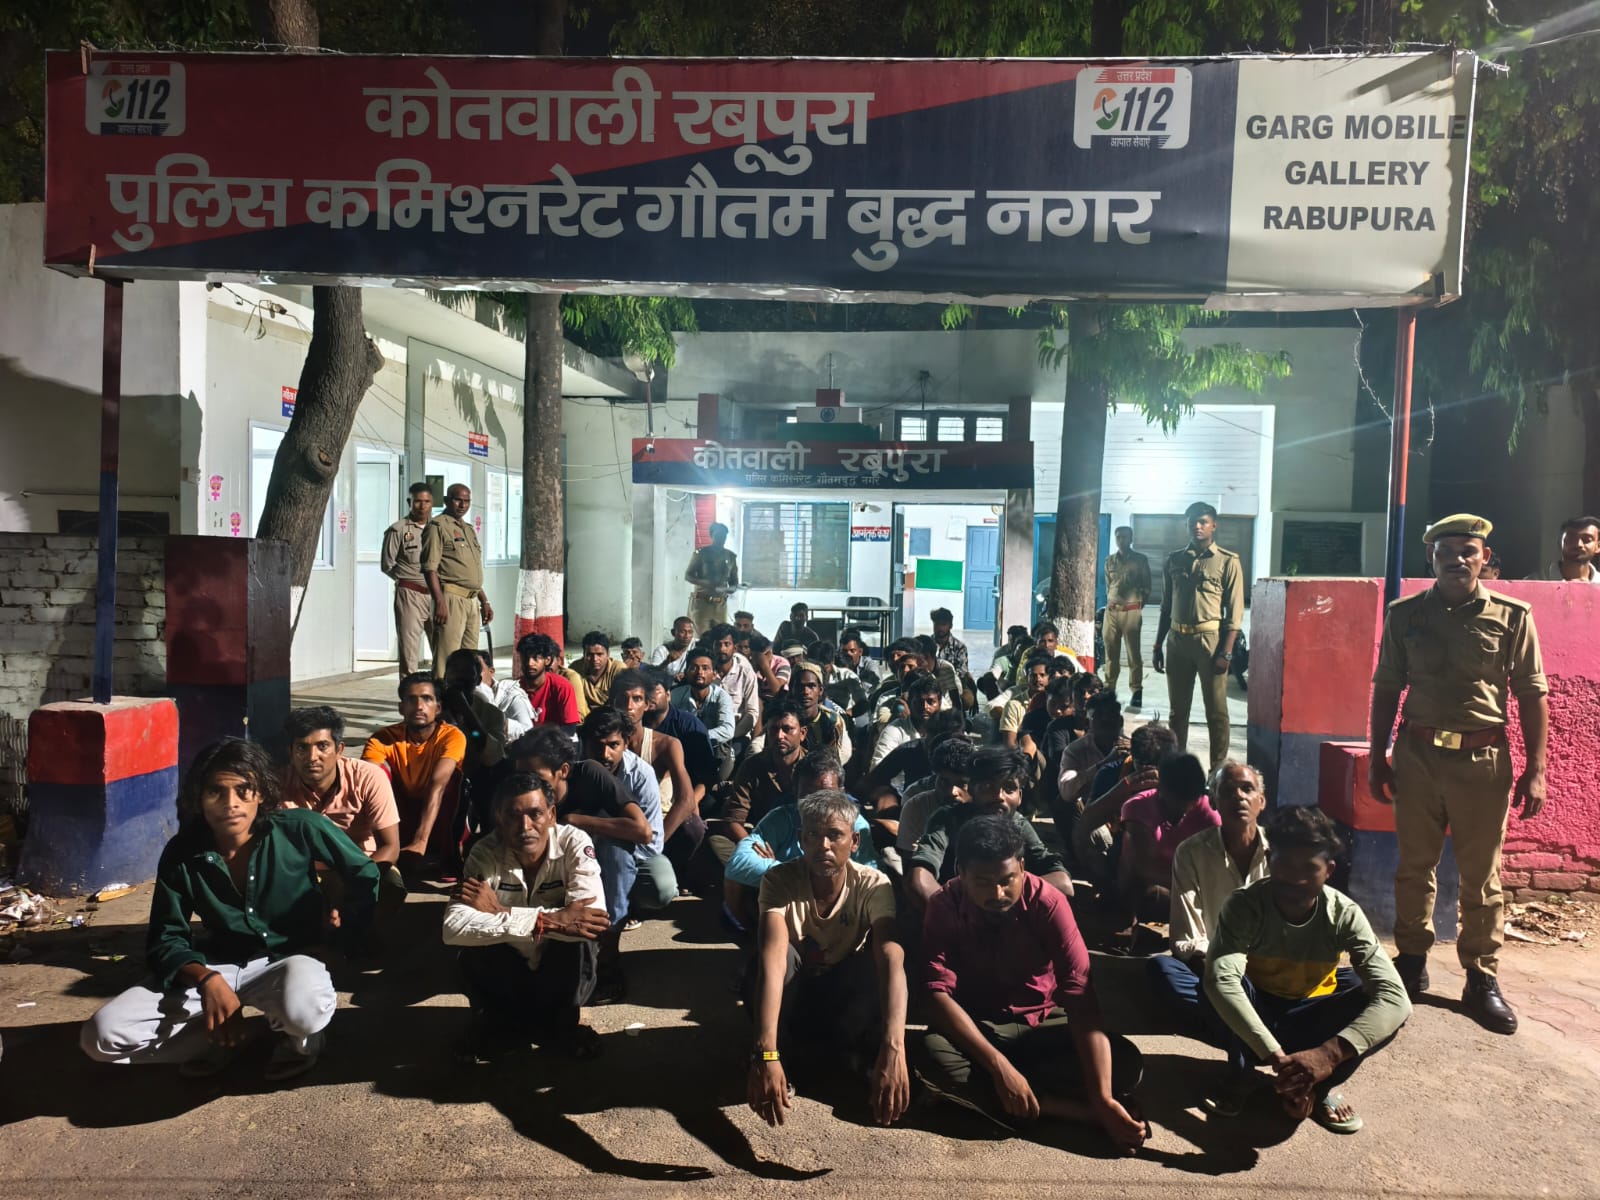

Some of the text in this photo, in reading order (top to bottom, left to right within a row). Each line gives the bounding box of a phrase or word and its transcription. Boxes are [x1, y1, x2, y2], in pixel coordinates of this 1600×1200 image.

[126, 79, 170, 120] 112
[1121, 87, 1174, 131] 112
[363, 66, 875, 175] कोतवाली रबूपुरा
[1246, 114, 1467, 140] GARG MOBILE
[1285, 160, 1430, 186] GALLERY
[106, 153, 1161, 272] पुलिस कमिश्नरेट गौतम बुद्ध नगर
[1263, 206, 1436, 231] RABUPURA
[693, 440, 948, 482] कोतवाली रबूपुरा
